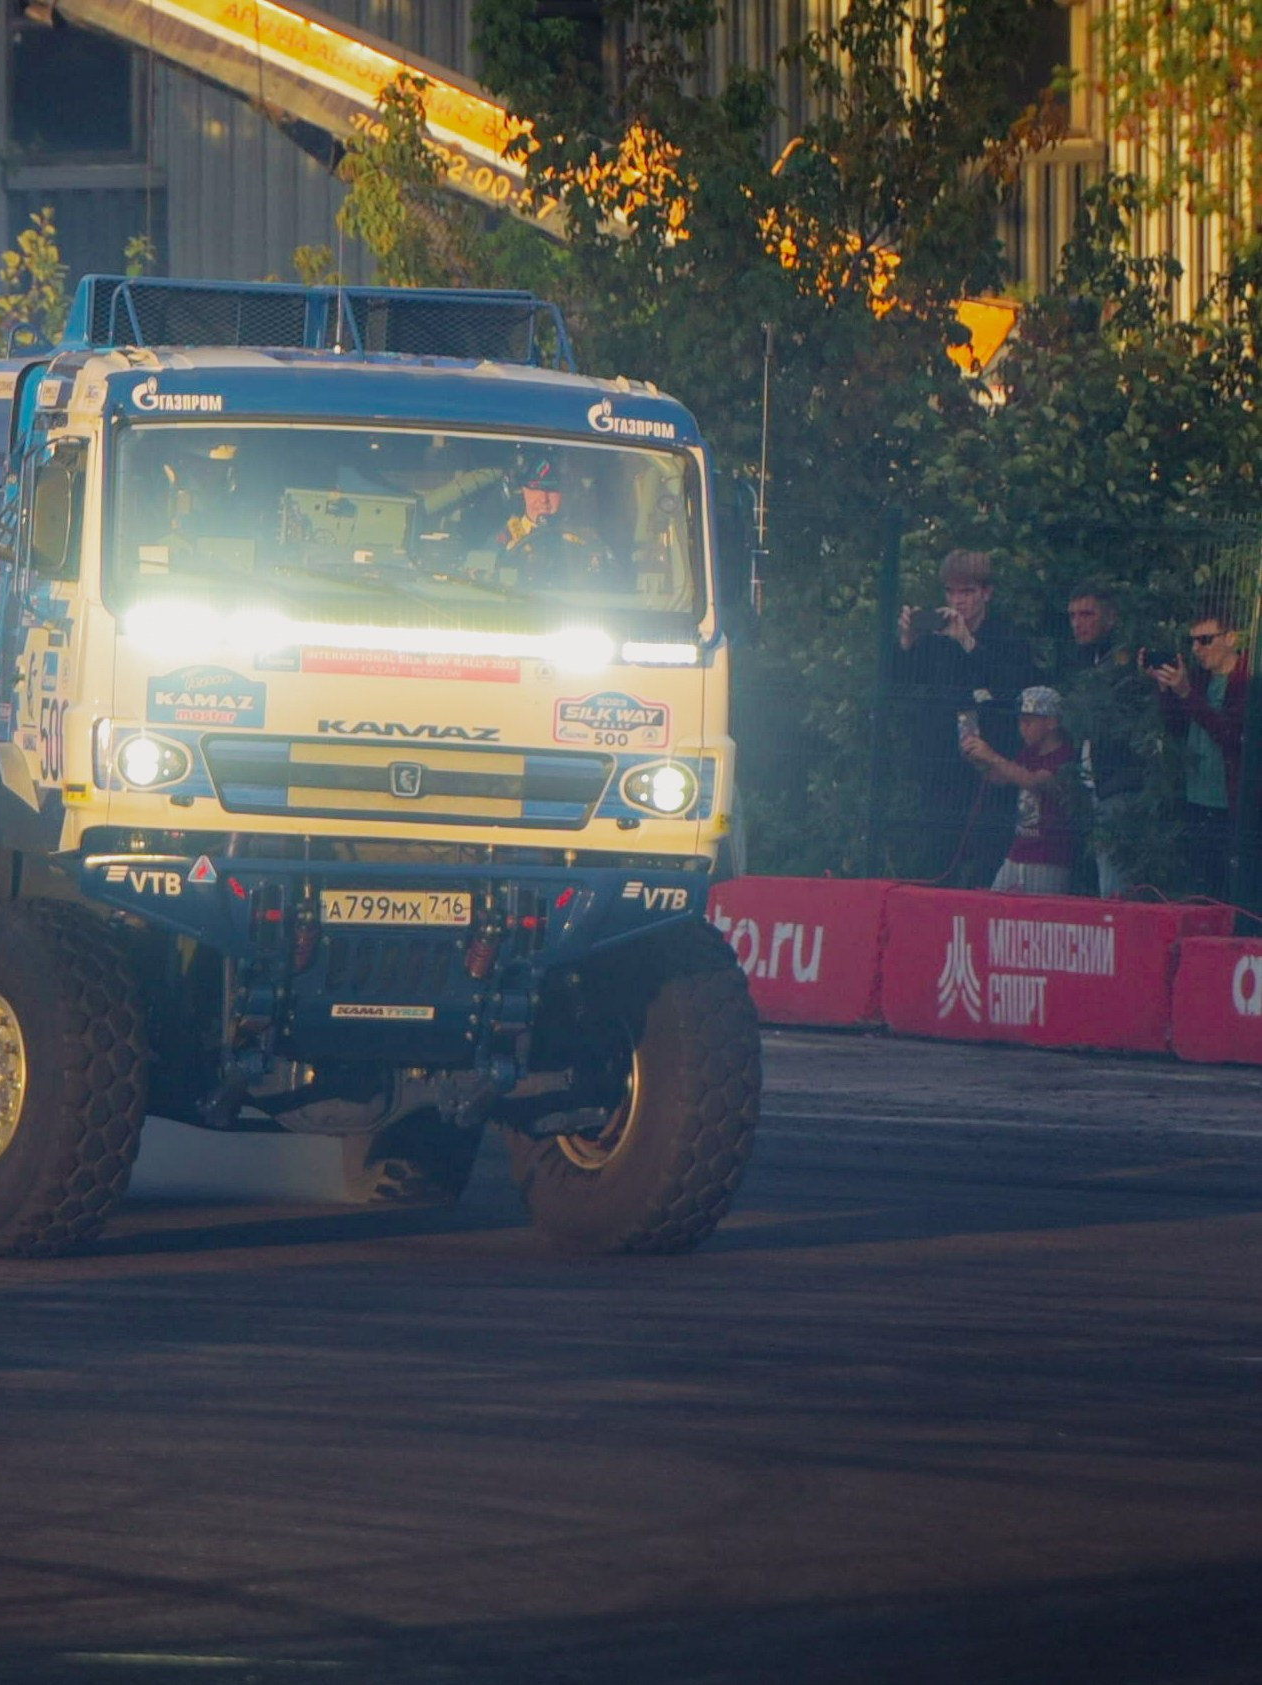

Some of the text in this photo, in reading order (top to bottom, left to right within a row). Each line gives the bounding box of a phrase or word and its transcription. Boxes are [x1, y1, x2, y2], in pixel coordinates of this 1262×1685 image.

[159, 394, 222, 411] ГАЗПРОМ
[613, 417, 675, 439] ГАЗПРОМ
[155, 691, 255, 711] KAMAZ
[175, 709, 237, 723] master
[564, 705, 660, 724] SILK WAY
[318, 719, 500, 743] KAMAZ
[594, 731, 629, 747] 500
[130, 871, 182, 895] VTB
[428, 896, 464, 915] 716
[643, 887, 688, 910] VTB
[704, 904, 824, 983] to.ru
[988, 915, 1115, 976] МОСКОВСКИЙ
[988, 973, 1047, 1027] СПОРТ
